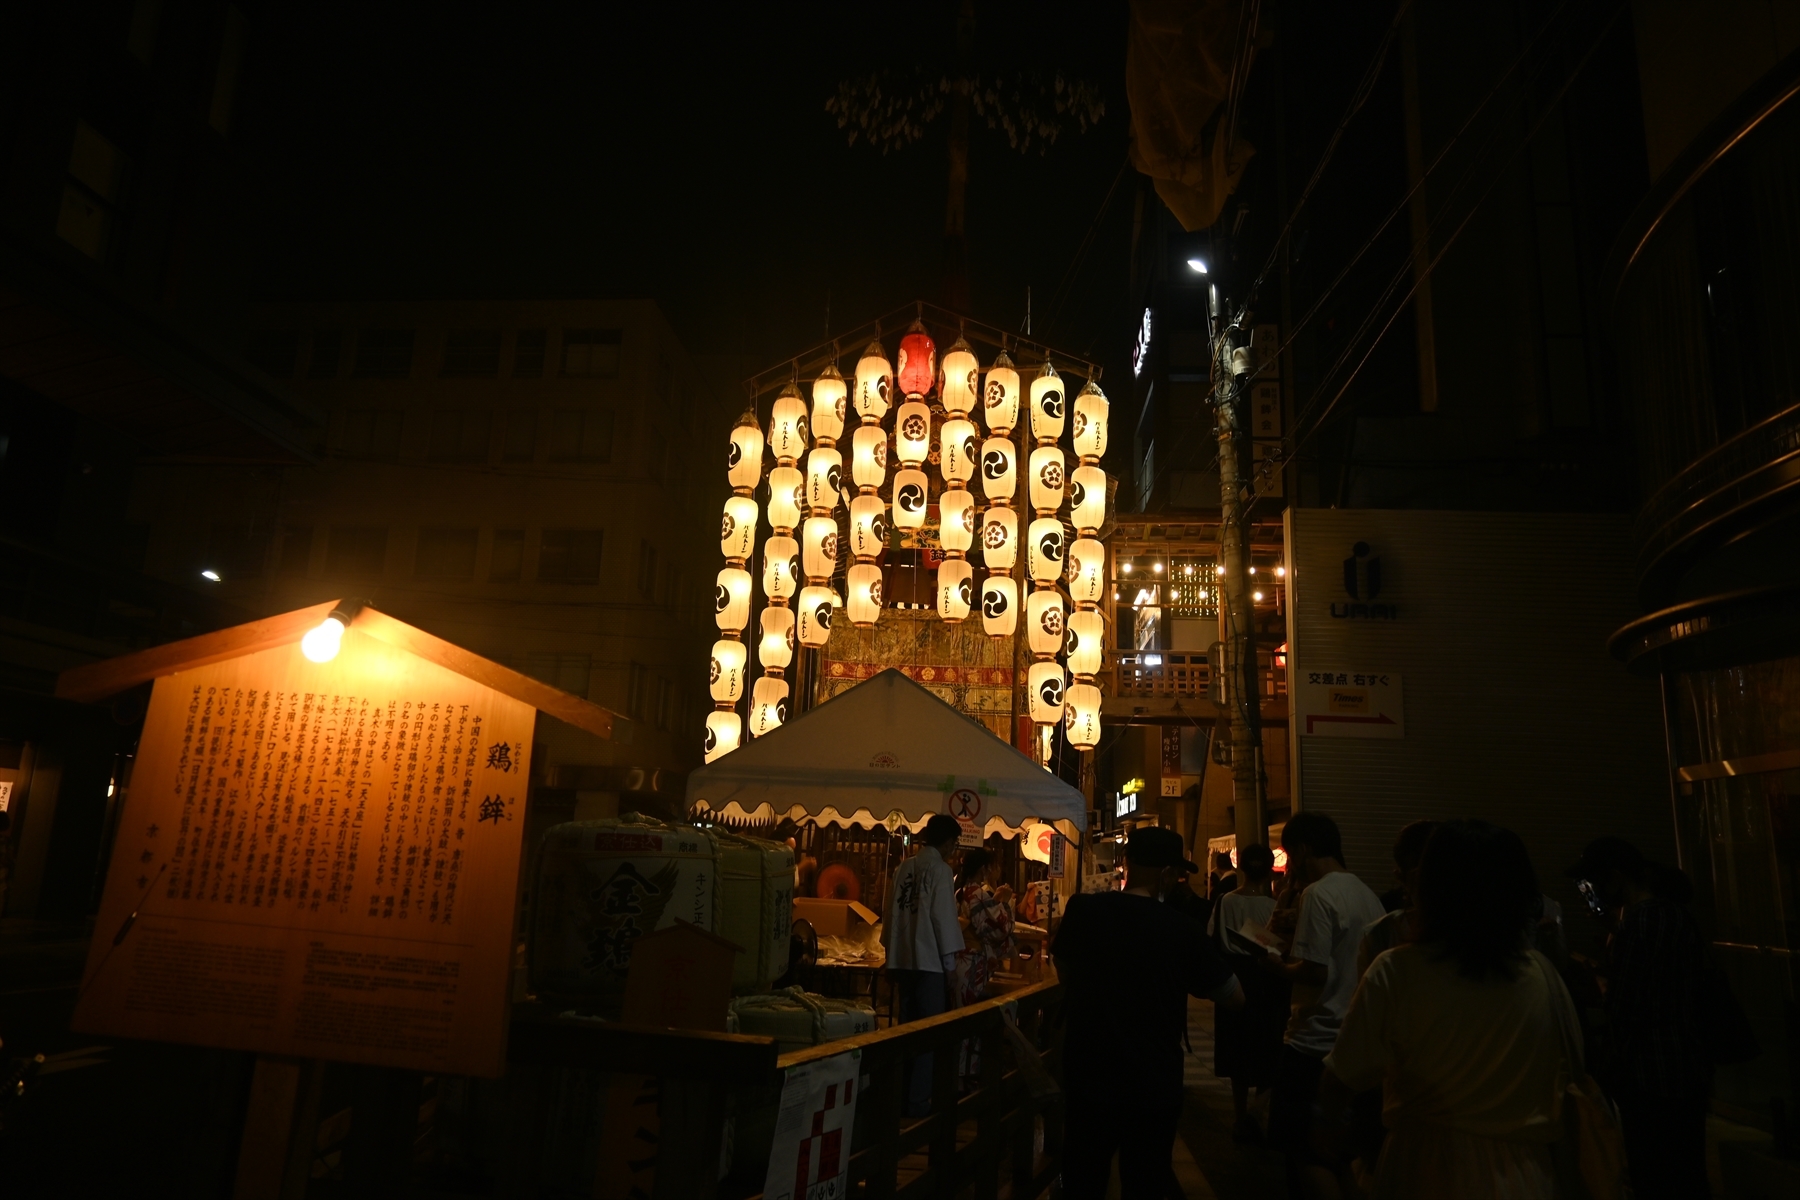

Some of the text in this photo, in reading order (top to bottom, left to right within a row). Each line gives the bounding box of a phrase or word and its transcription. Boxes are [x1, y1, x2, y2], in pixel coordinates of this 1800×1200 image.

[1330, 602, 1398, 620] URAI
[1308, 672, 1390, 687] 交差点 右すぐ
[1332, 693, 1364, 703] Times
[477, 741, 512, 826] 鶏鉾
[1165, 785, 1178, 795] 2F
[600, 835, 656, 850] 京仕込
[692, 873, 706, 927] キンシ正
